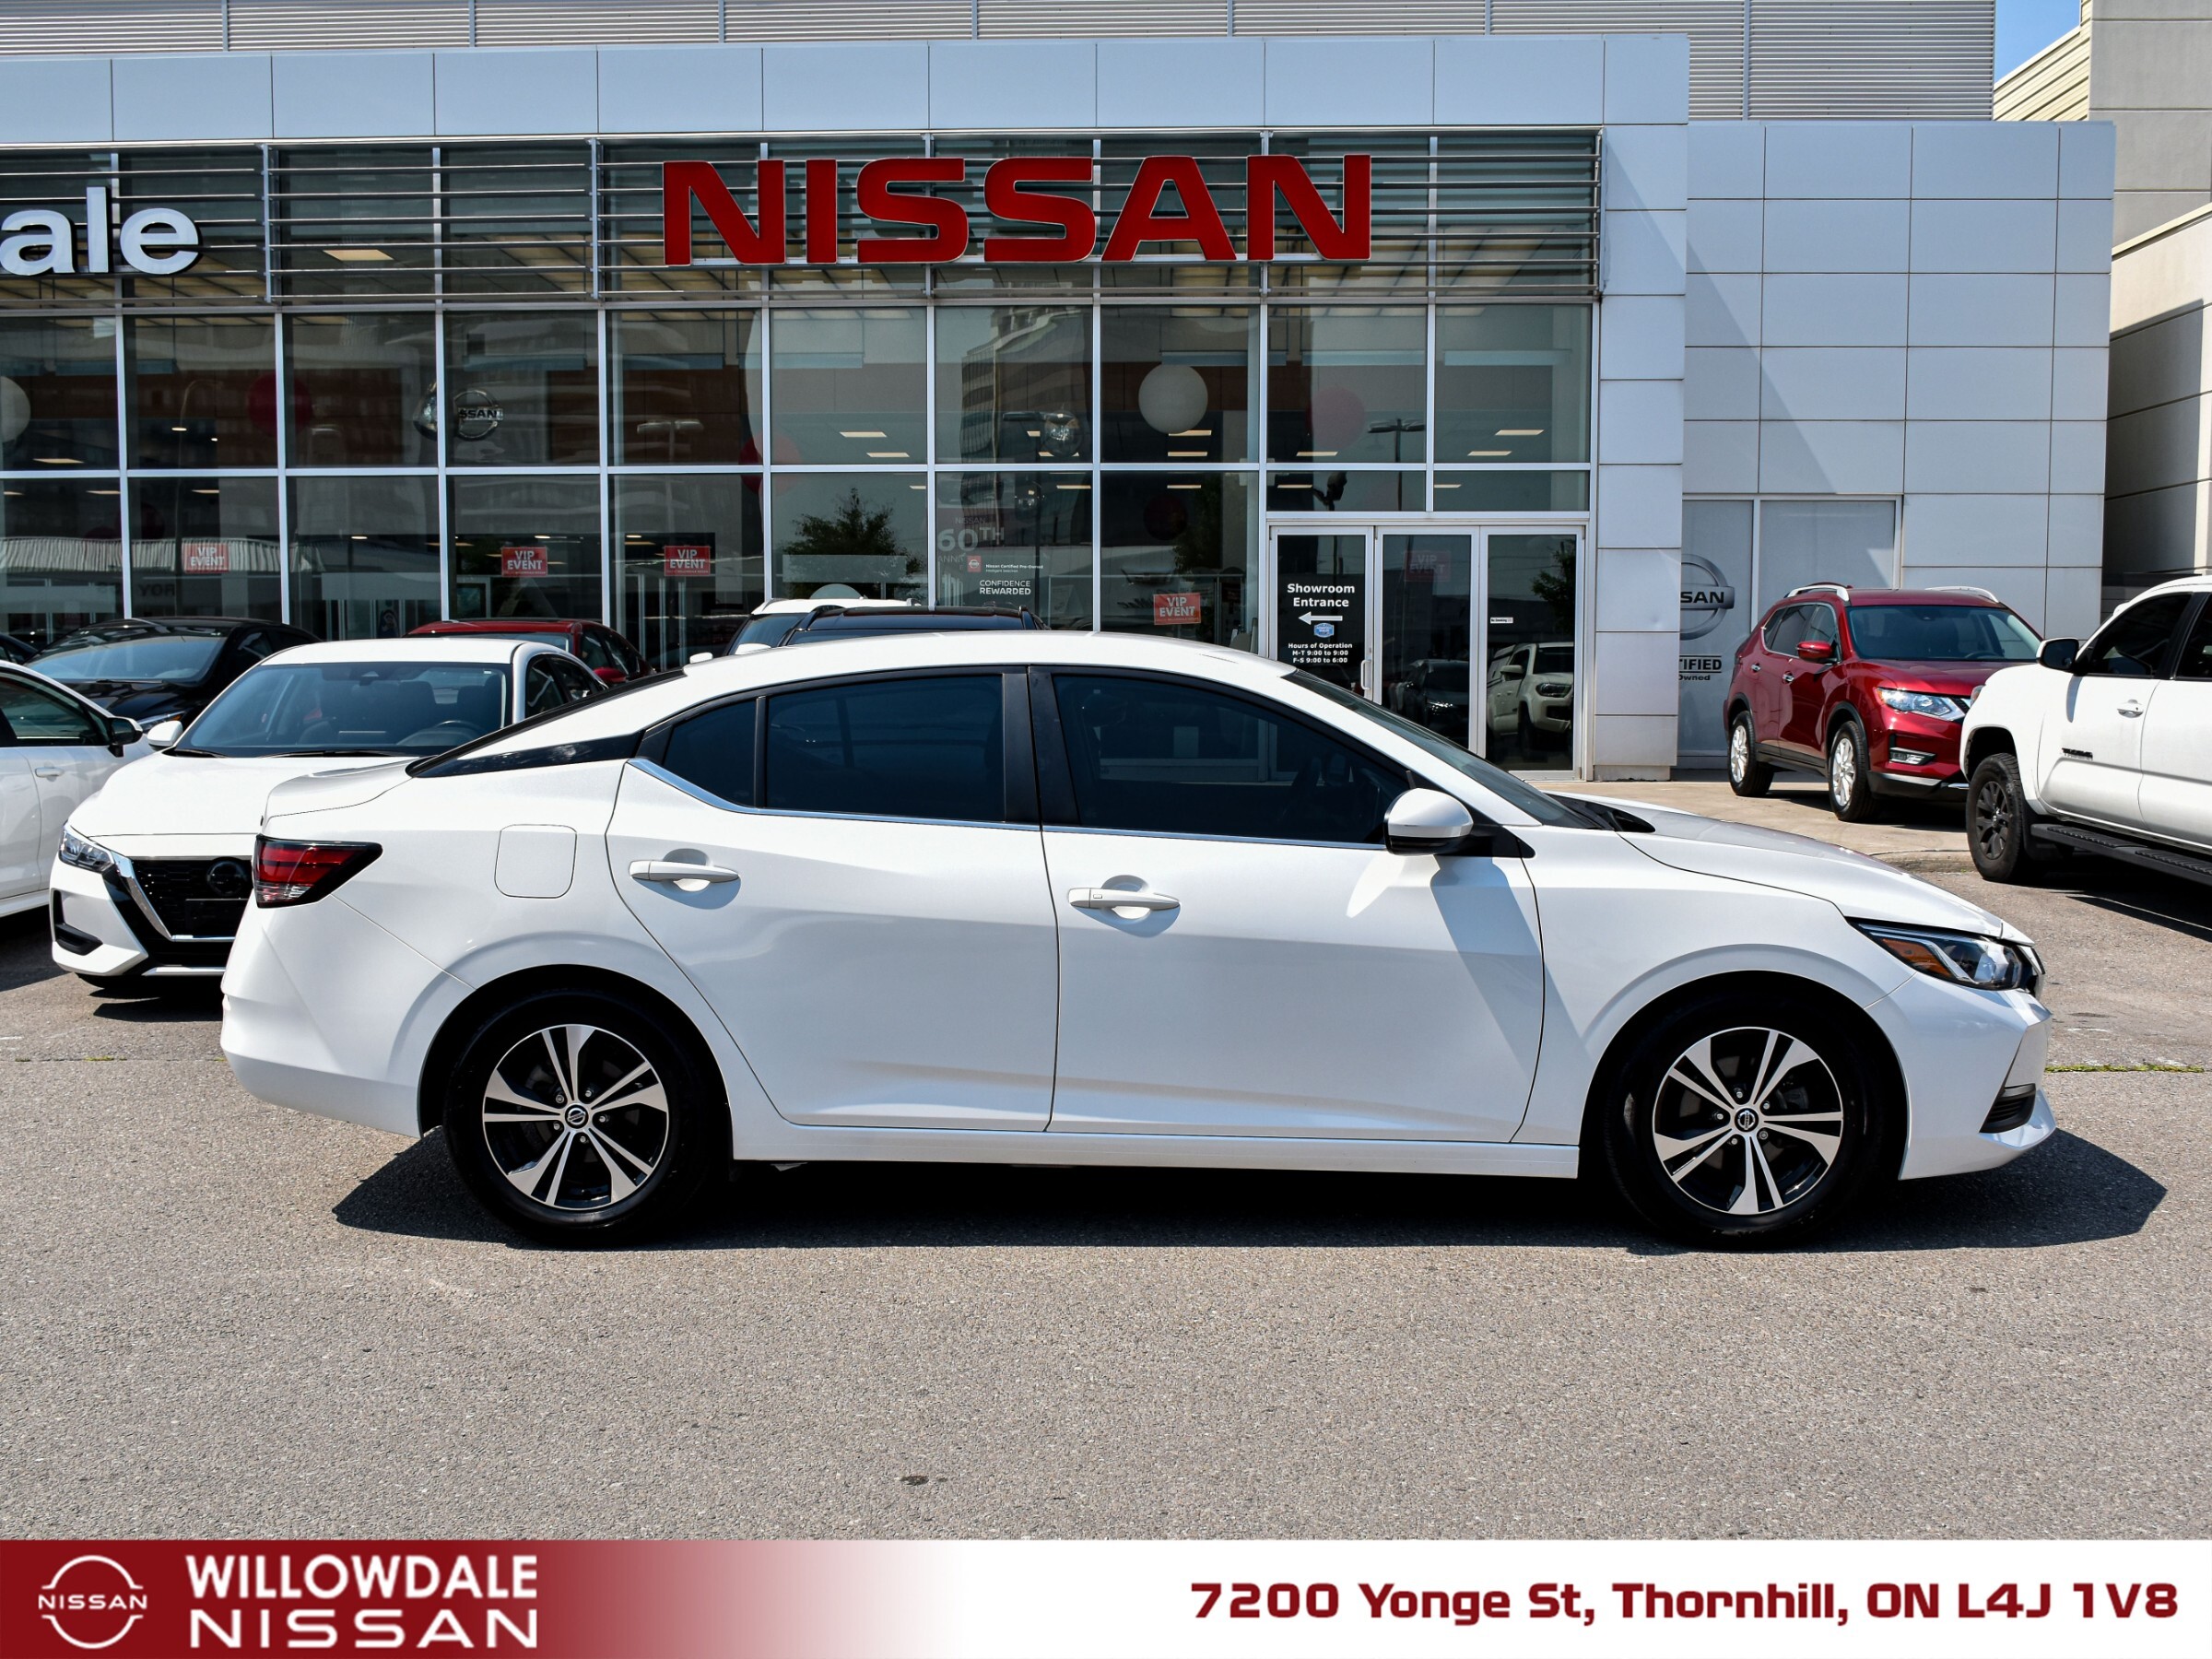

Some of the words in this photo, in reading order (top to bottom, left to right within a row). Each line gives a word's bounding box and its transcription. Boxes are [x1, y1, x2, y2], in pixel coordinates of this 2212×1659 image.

[663, 154, 1371, 265] NISSAN
[0, 186, 200, 276] ale
[955, 516, 986, 524] NISSAN
[198, 547, 217, 557] VIP
[515, 550, 535, 560] VIP
[677, 549, 698, 559] VIP
[191, 556, 225, 567] EVENT
[507, 559, 542, 570] EVENT
[669, 559, 705, 569] EVENT
[1418, 554, 1437, 564] VIP
[979, 587, 1031, 595] REWARDED
[1287, 582, 1356, 594] Showroom
[1167, 596, 1187, 607] VIP
[1293, 596, 1349, 607] Entrance
[1159, 606, 1195, 618] EVENT
[1679, 659, 1722, 670] IFIED
